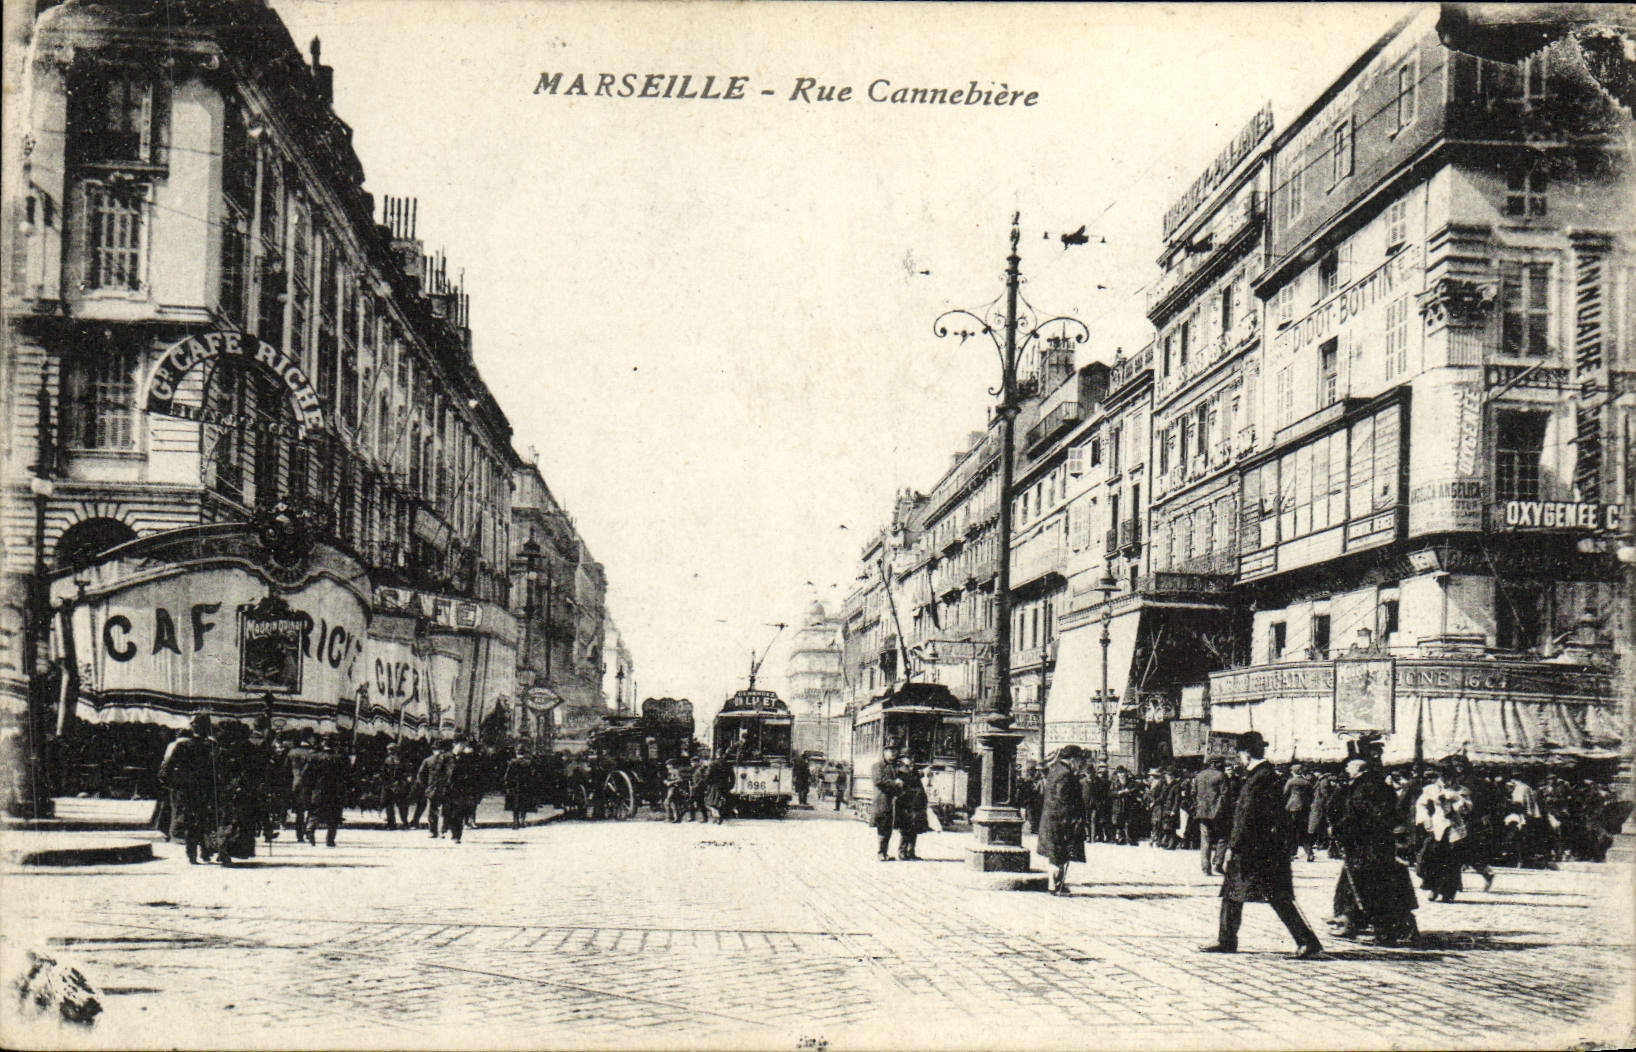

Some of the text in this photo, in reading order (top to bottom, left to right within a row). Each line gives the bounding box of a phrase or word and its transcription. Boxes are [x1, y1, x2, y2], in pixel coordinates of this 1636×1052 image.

[254, 340, 325, 429] RICHE
[1506, 500, 1598, 529] OXYGENEE
[103, 599, 240, 664] CAF
[746, 780, 767, 791] 696
